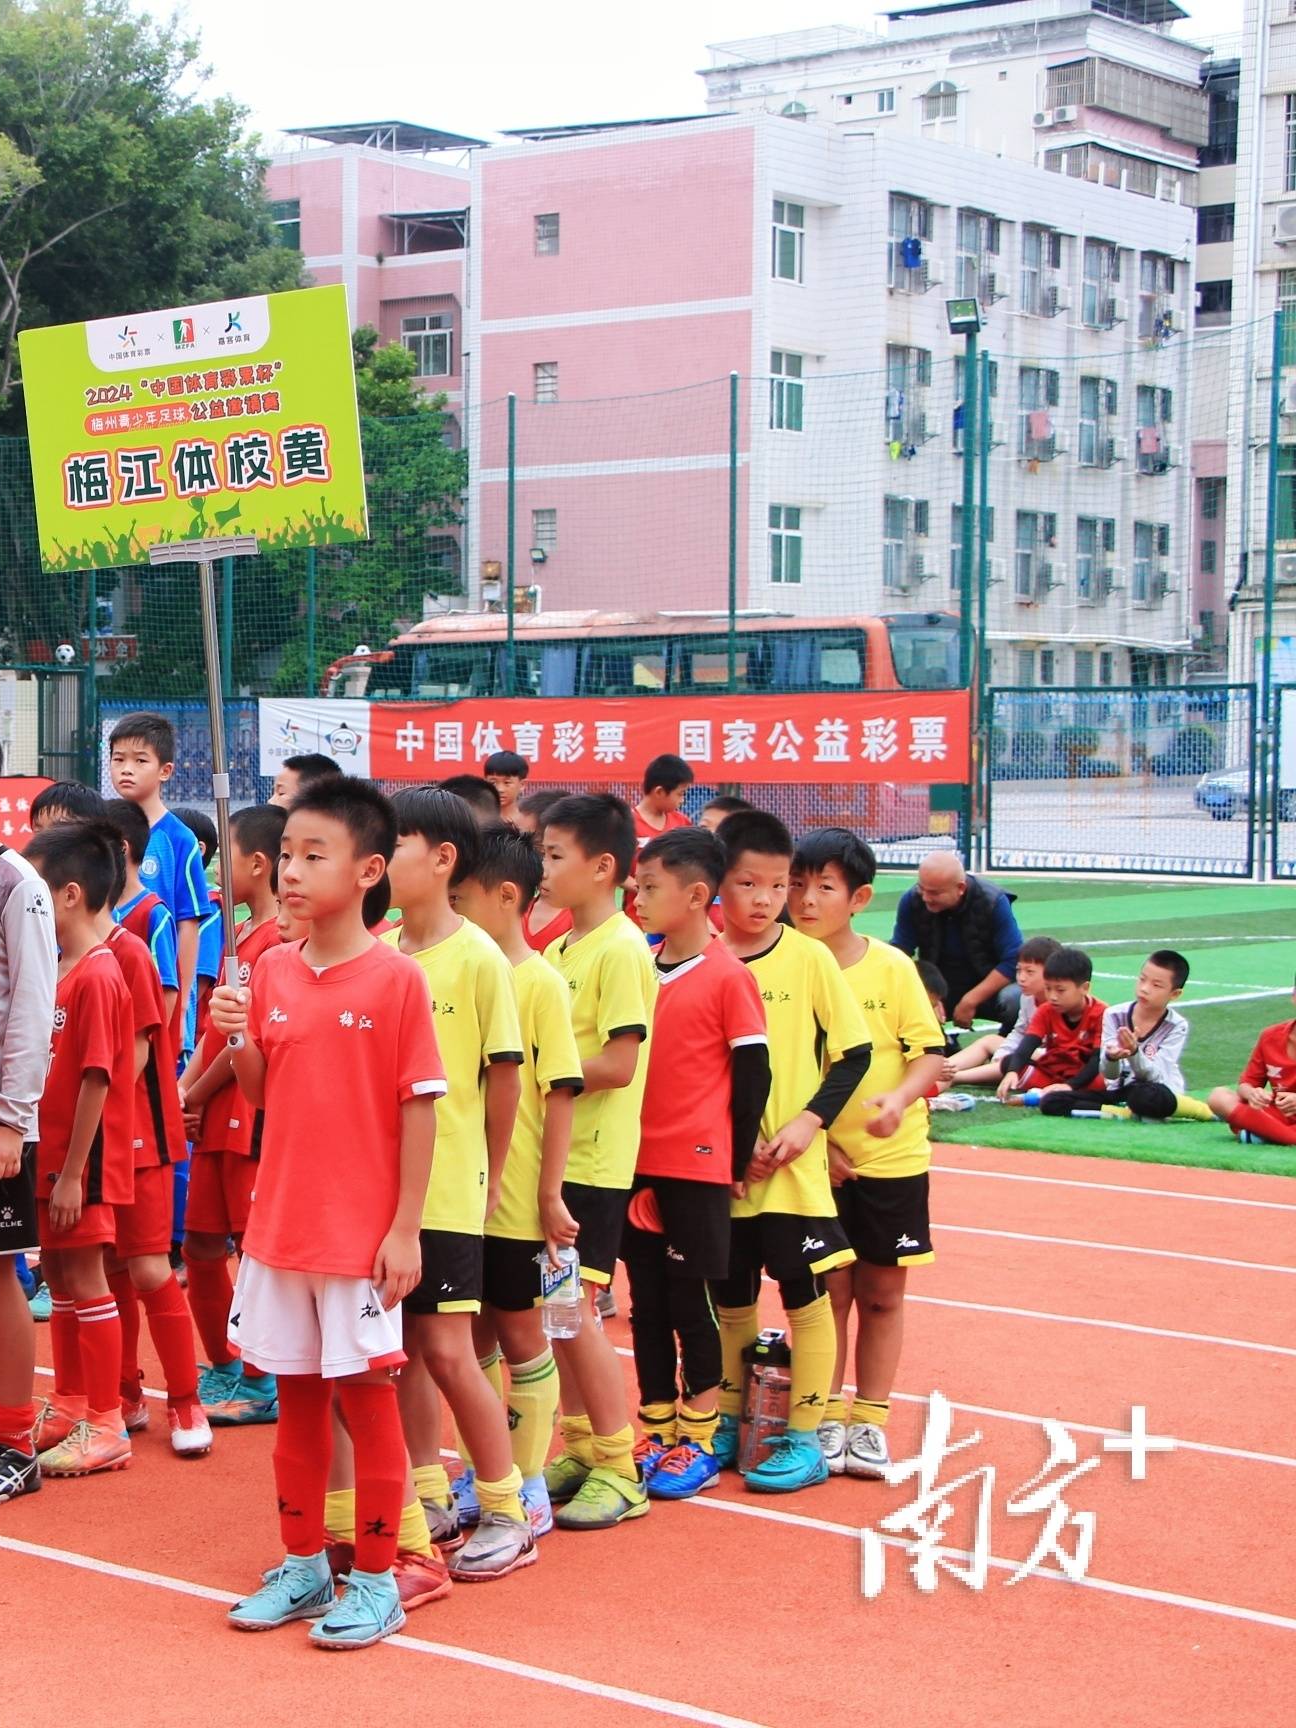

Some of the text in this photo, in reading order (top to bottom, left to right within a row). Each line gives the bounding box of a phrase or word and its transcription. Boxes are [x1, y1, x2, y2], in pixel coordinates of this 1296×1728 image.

[108, 348, 151, 360] 中国体育彩票
[85, 384, 133, 406] 2024
[65, 427, 331, 508] 梅江体校黄
[395, 716, 948, 763] 中国体育彩票 国家公益彩票
[339, 1010, 373, 1030] 梅江
